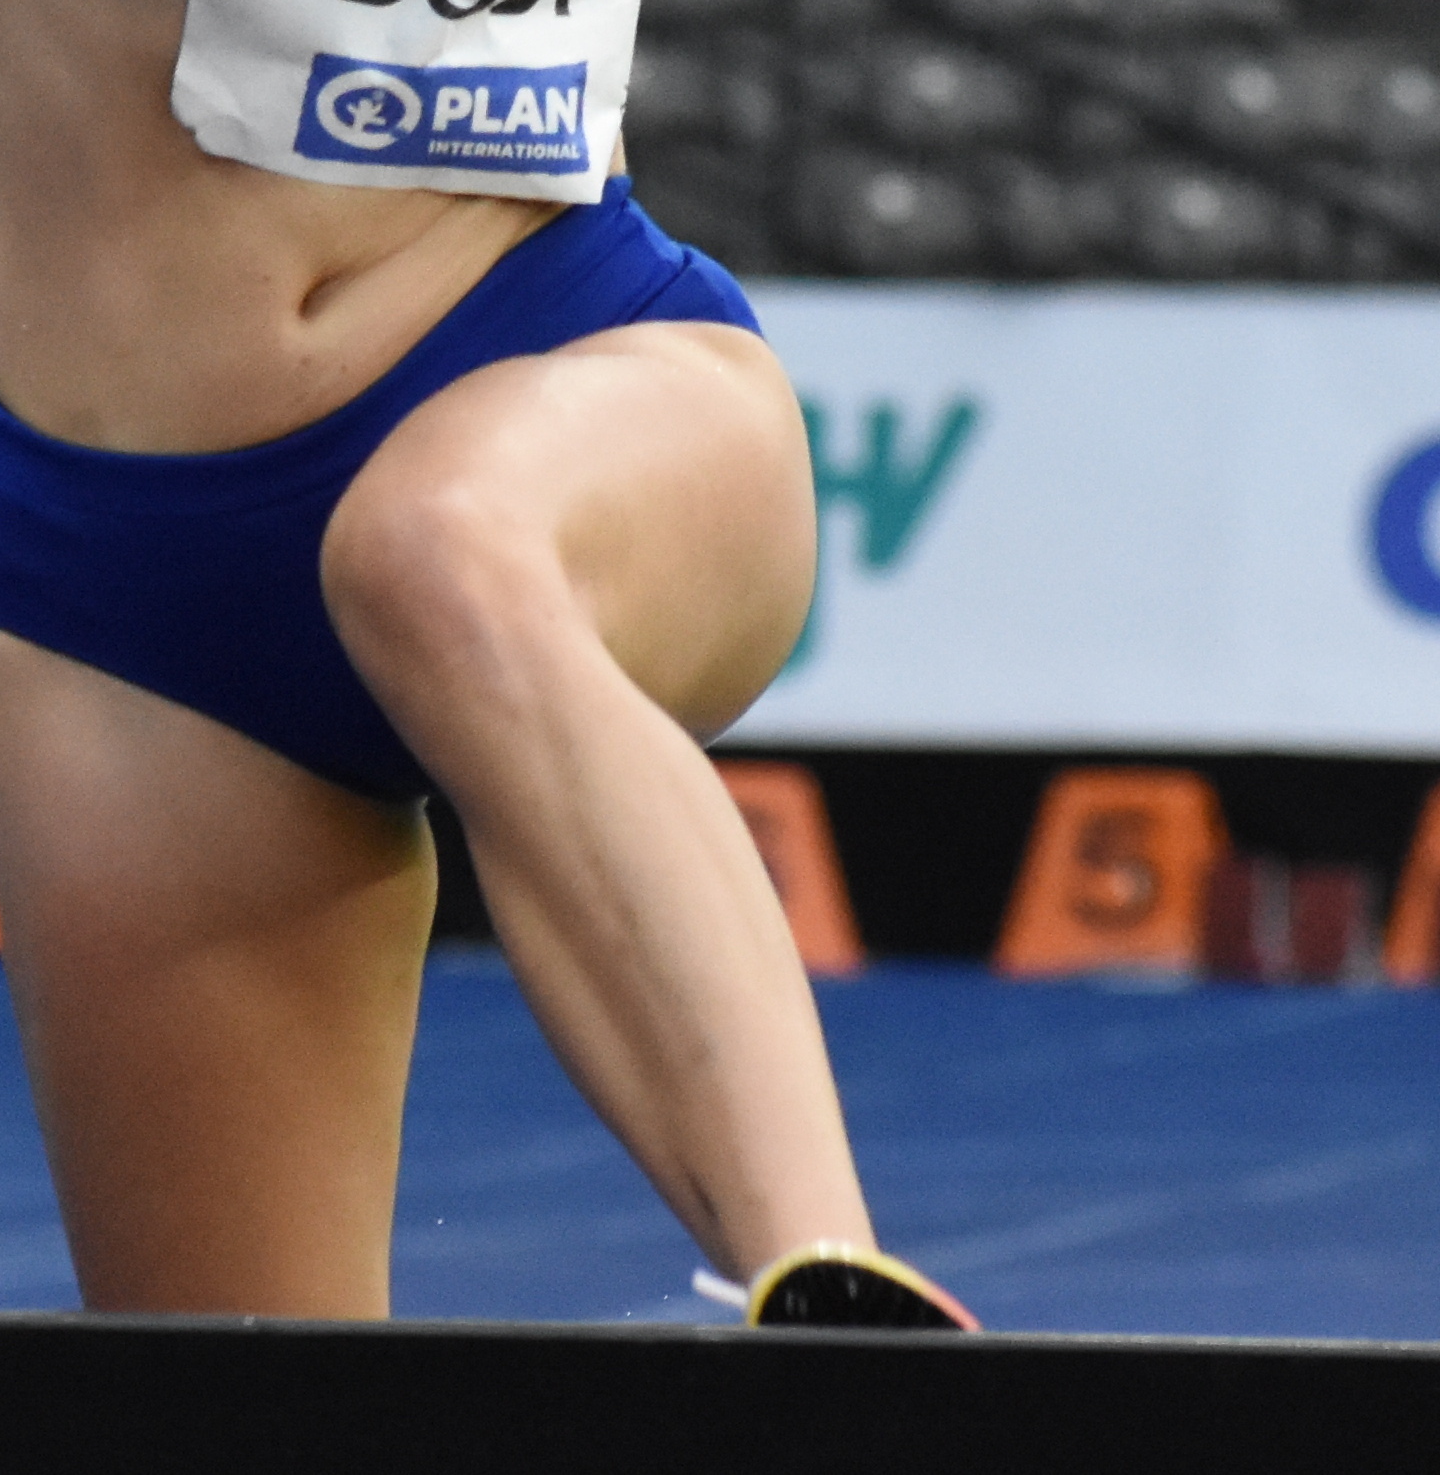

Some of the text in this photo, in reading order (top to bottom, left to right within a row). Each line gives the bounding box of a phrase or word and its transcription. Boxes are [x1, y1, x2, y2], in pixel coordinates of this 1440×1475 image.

[432, 84, 580, 135] PLAN
[428, 139, 581, 162] INTERNATIONAL
[1073, 803, 1158, 928] 5
